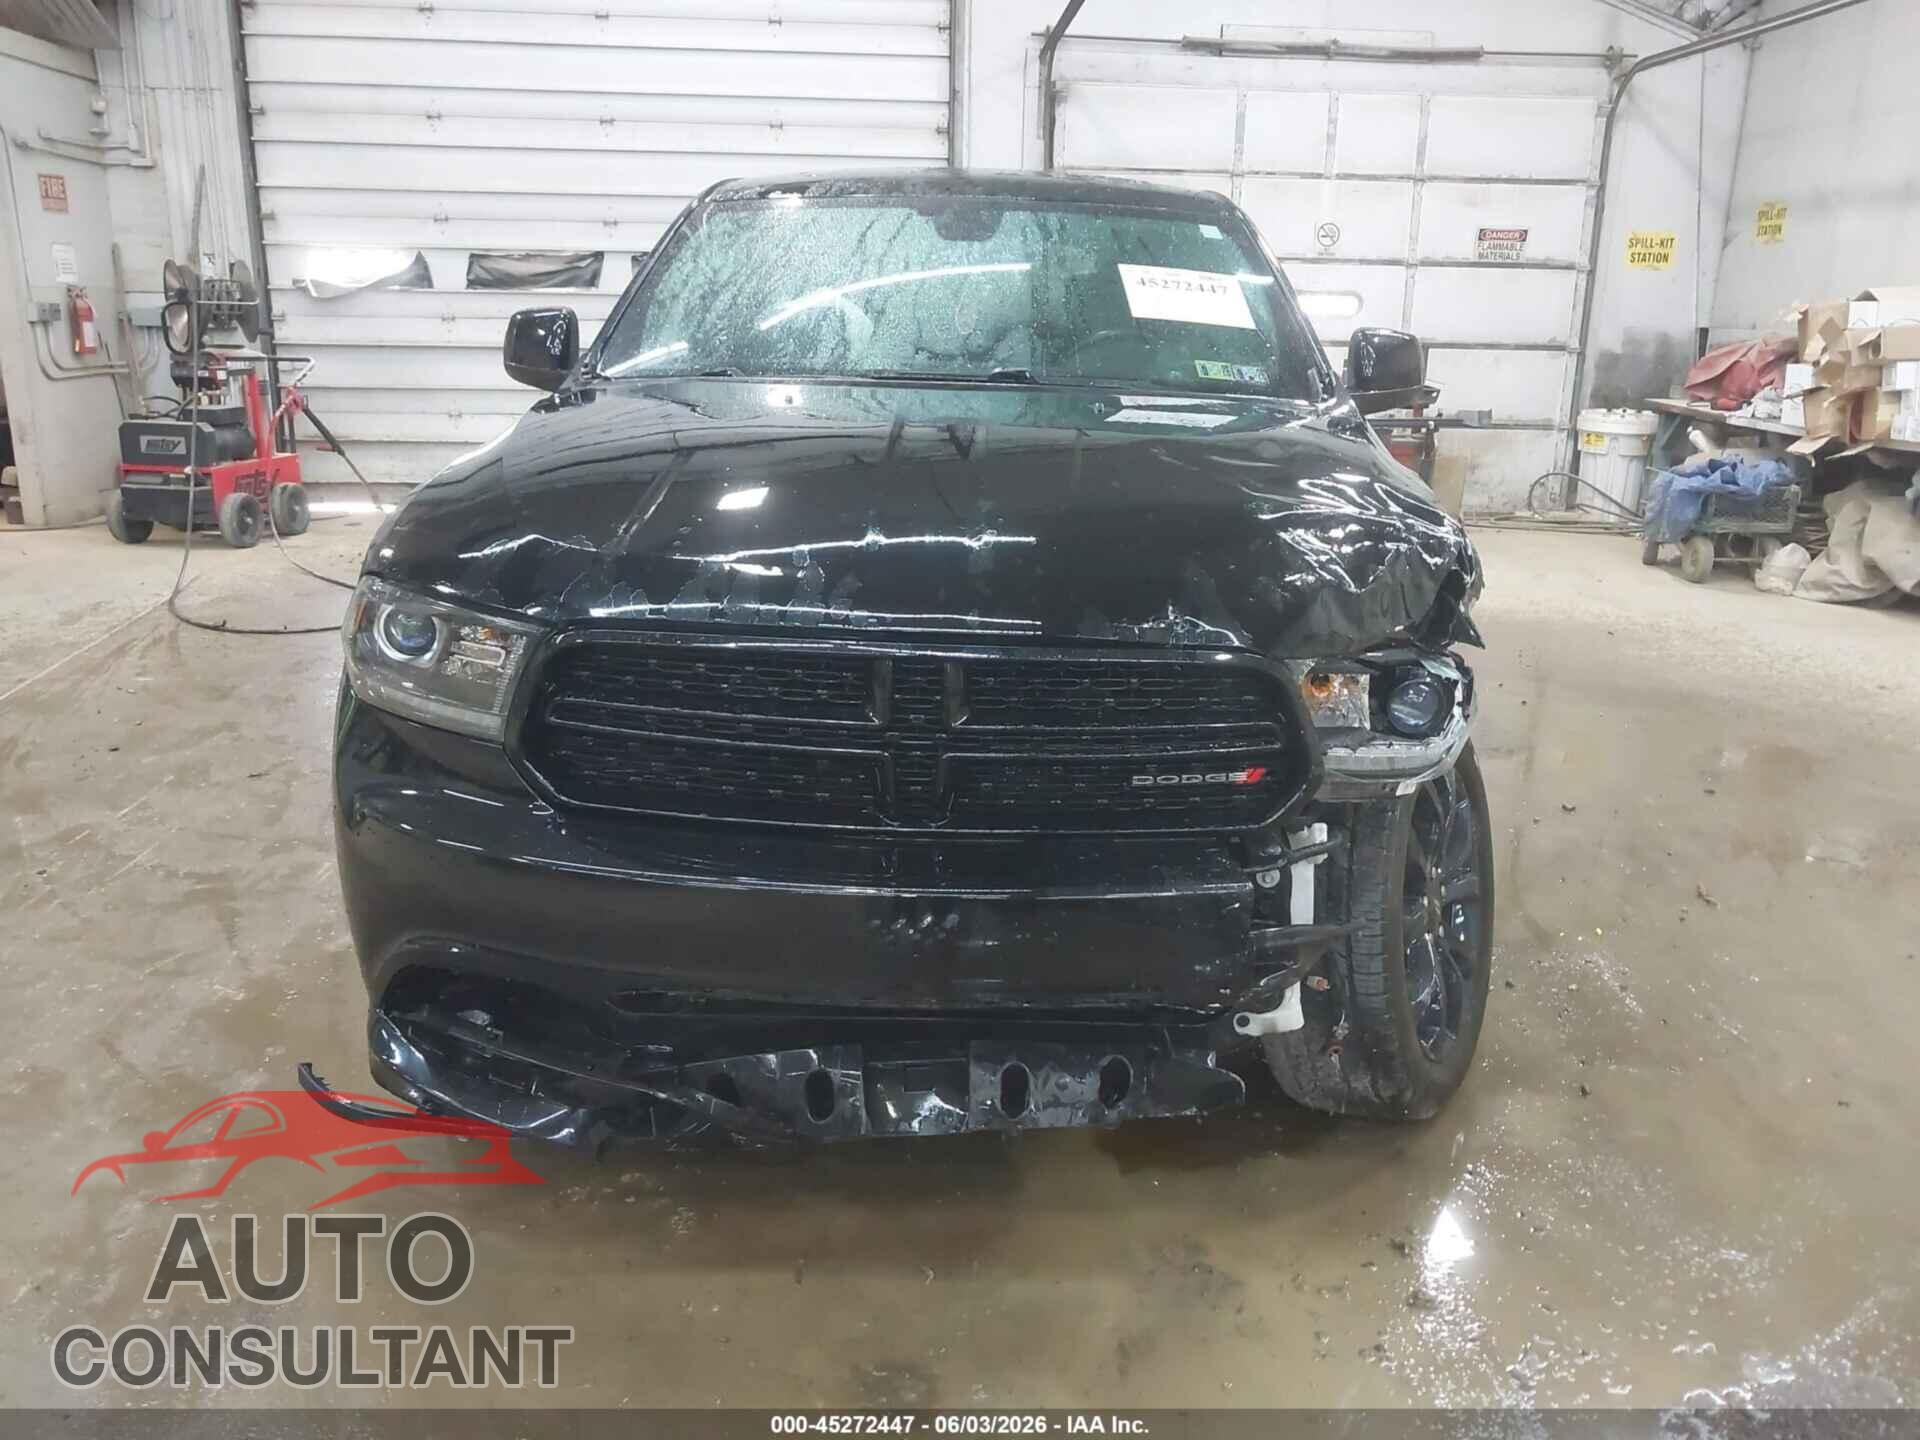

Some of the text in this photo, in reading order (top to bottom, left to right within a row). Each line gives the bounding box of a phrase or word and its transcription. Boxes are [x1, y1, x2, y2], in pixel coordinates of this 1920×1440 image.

[40, 177, 65, 197] FIRE
[1485, 231, 1521, 239] DANGER
[1756, 224, 1782, 237] STATION
[1477, 241, 1525, 250] FLAMMABLE
[1628, 237, 1675, 249] SPILL-KIT
[1478, 251, 1520, 261] MATERIALS
[1630, 251, 1669, 264] STATION
[1132, 772, 1249, 784] DODGE
